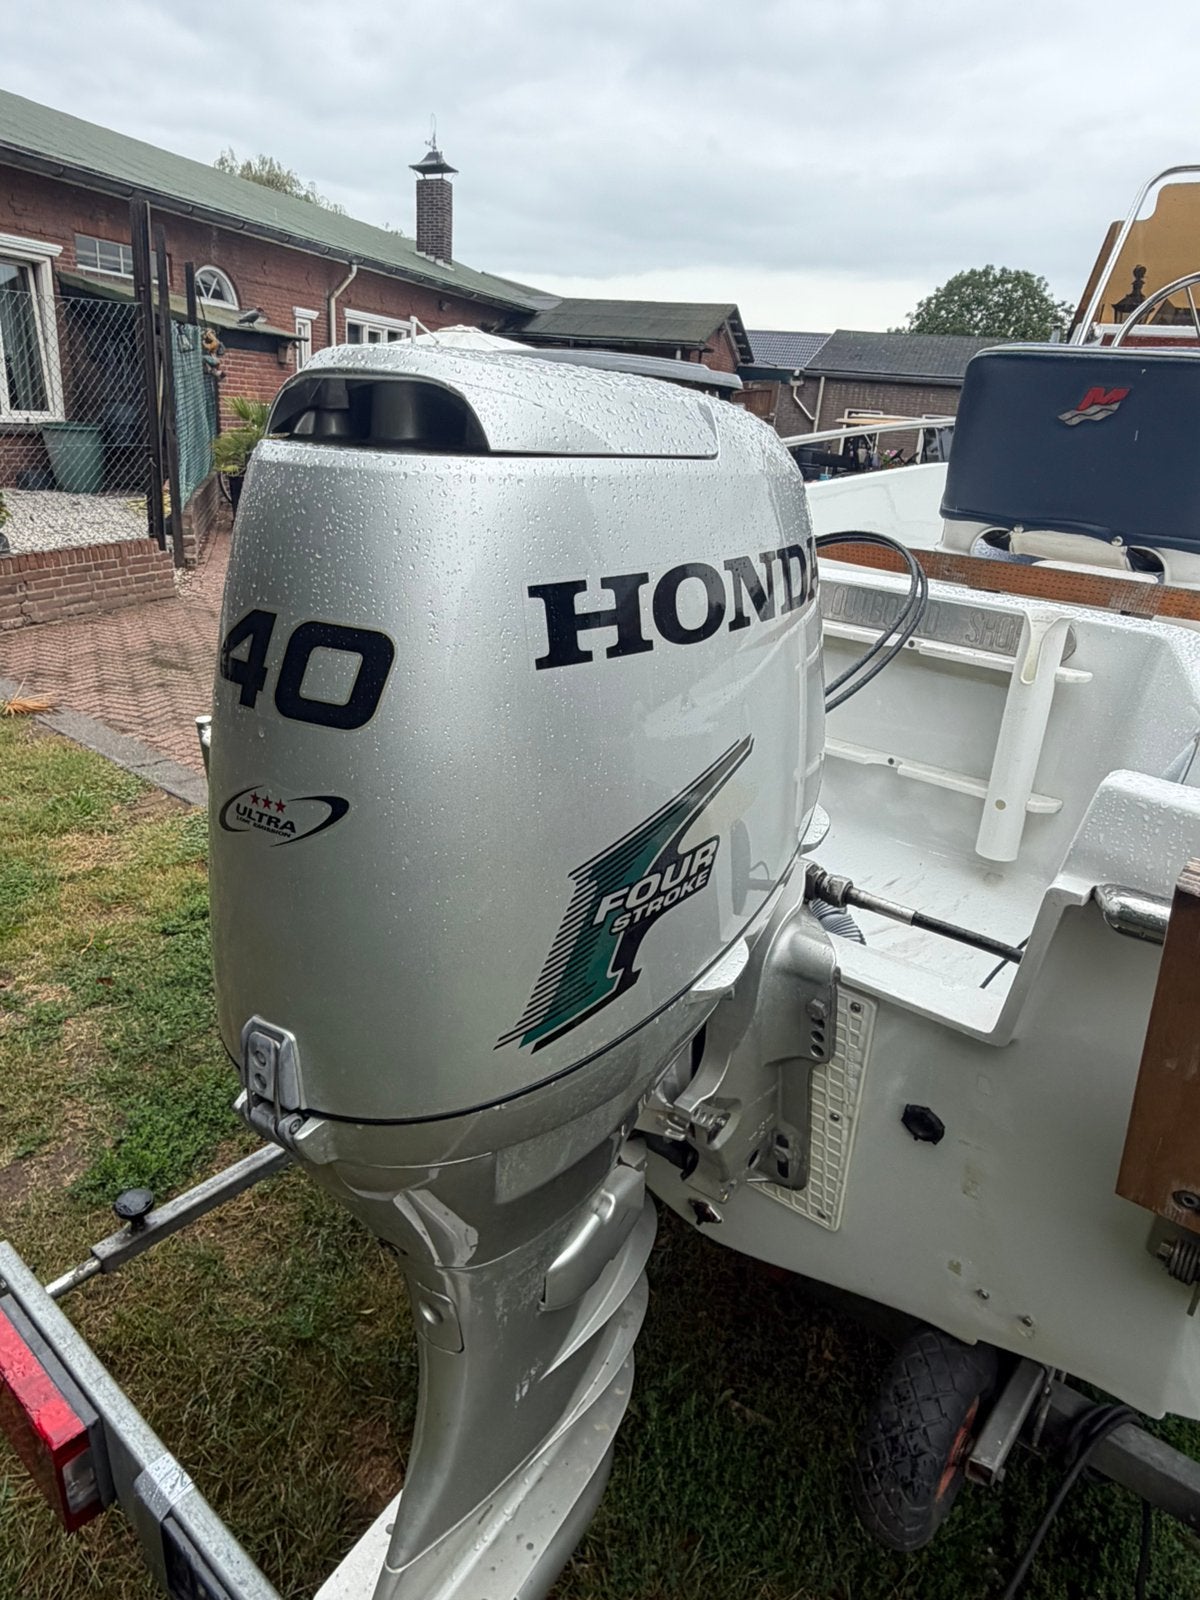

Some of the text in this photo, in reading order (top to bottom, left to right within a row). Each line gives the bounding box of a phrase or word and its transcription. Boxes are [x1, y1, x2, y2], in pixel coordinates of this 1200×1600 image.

[831, 584, 941, 635] OUTBOD
[220, 609, 395, 730] 40
[235, 803, 297, 833] ULTRA
[593, 840, 718, 925] FOUR
[611, 869, 708, 934] STROKE
